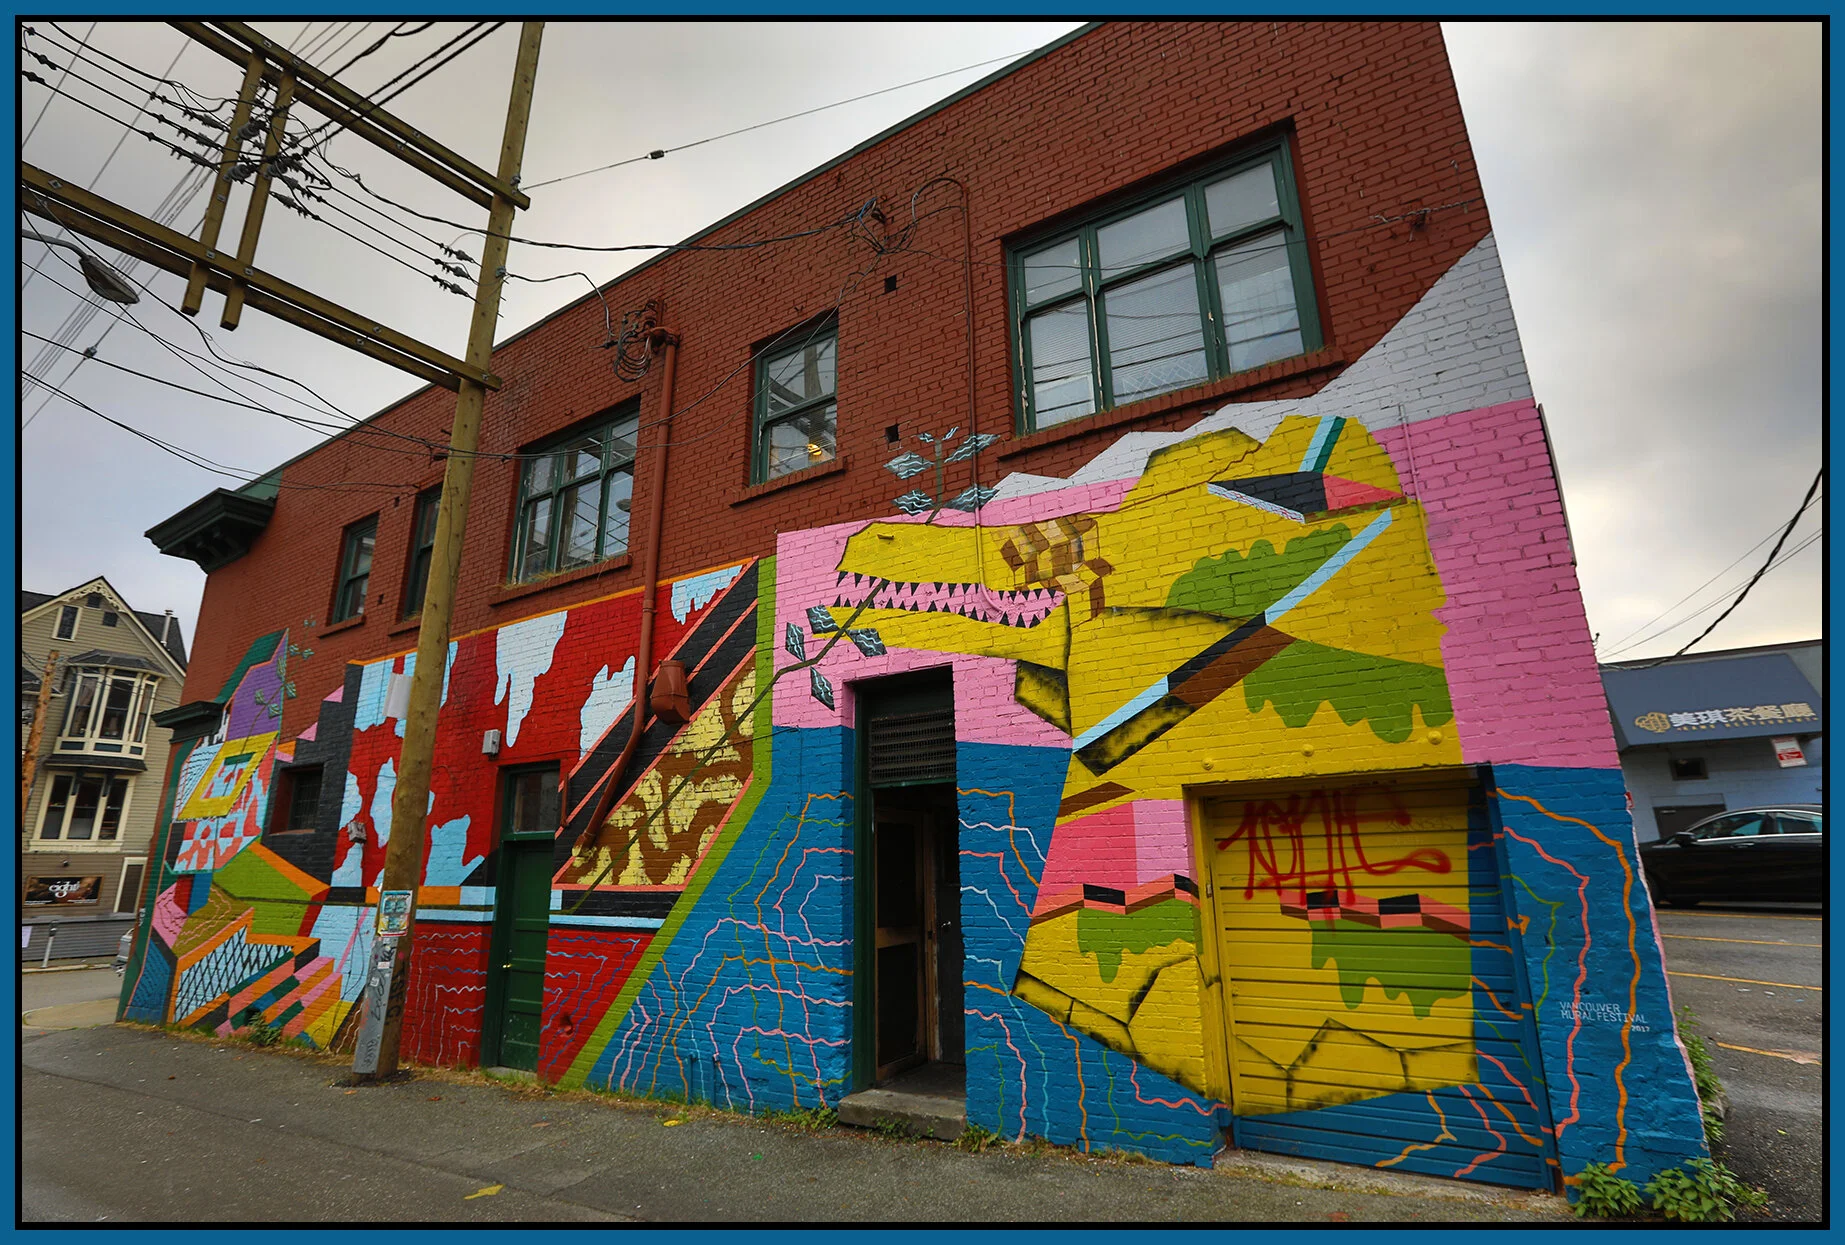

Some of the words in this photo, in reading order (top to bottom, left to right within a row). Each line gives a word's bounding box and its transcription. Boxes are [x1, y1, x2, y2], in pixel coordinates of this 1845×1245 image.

[1668, 702, 1817, 728] 美琪茶餐廳
[1559, 1002, 1621, 1013] VANCOUVER
[1560, 1010, 1595, 1021] MURAL
[1597, 1012, 1648, 1023] FESTIVAL
